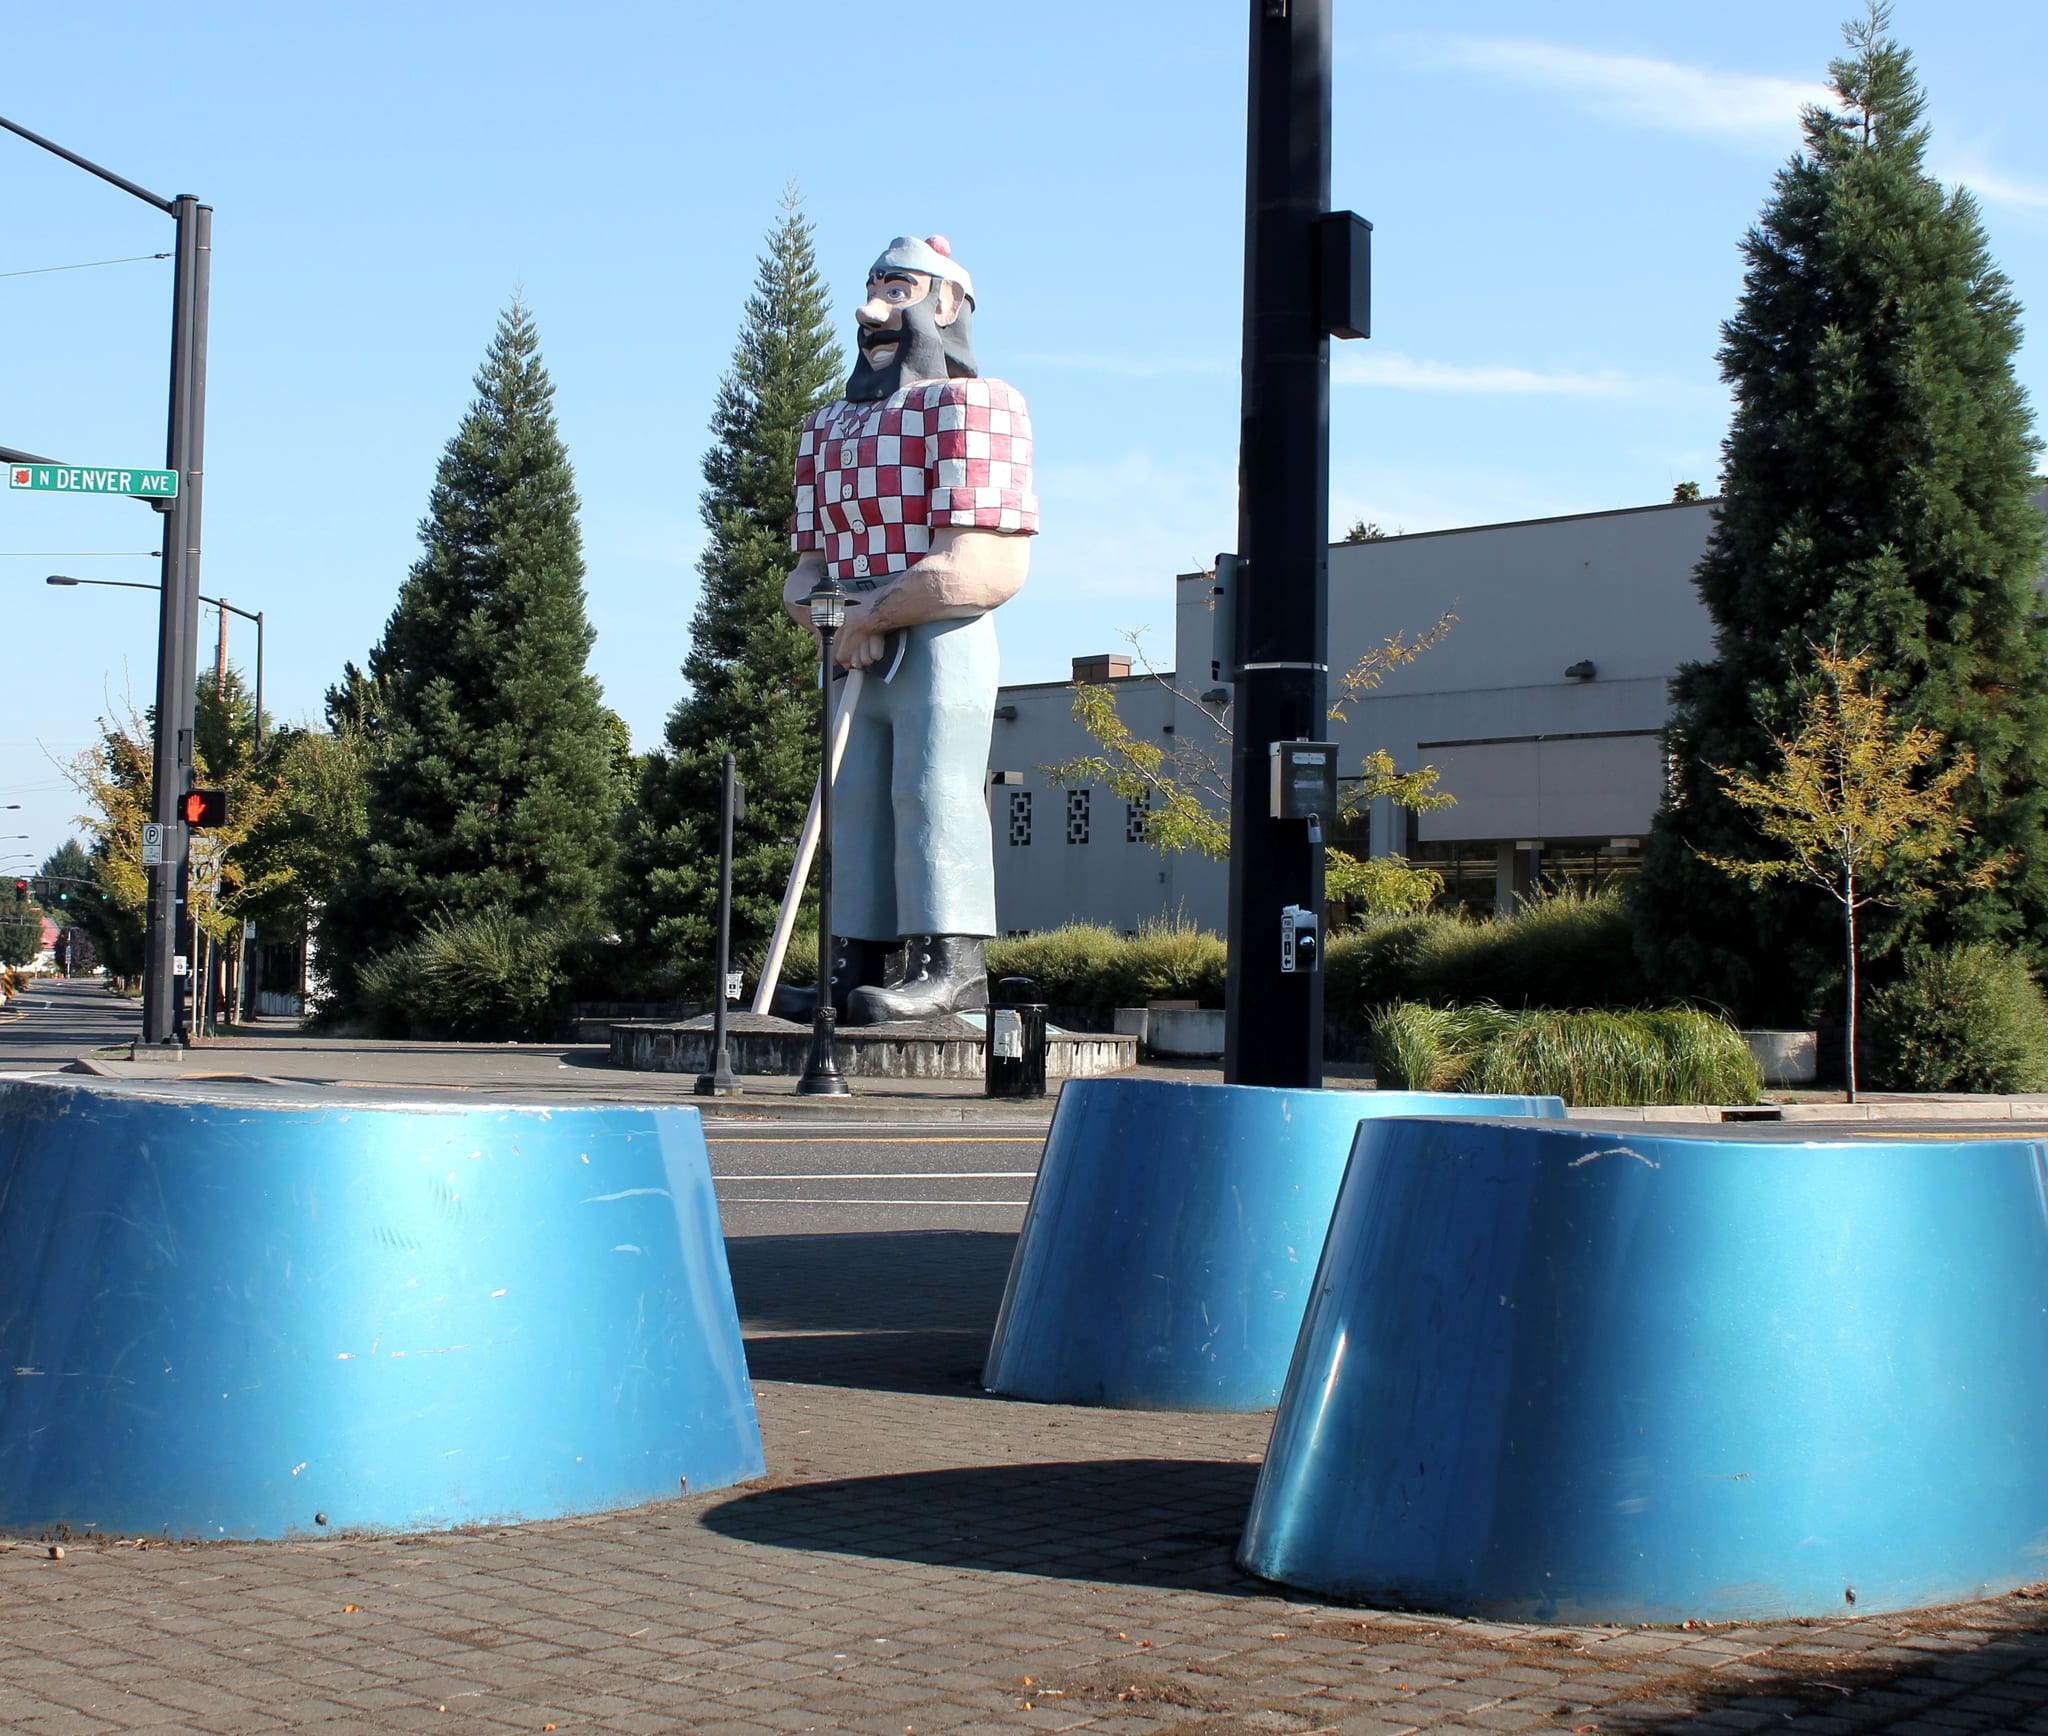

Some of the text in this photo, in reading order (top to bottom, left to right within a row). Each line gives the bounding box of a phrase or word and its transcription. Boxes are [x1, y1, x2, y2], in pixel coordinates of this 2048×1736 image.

[39, 469, 169, 491] N DENVER AVE
